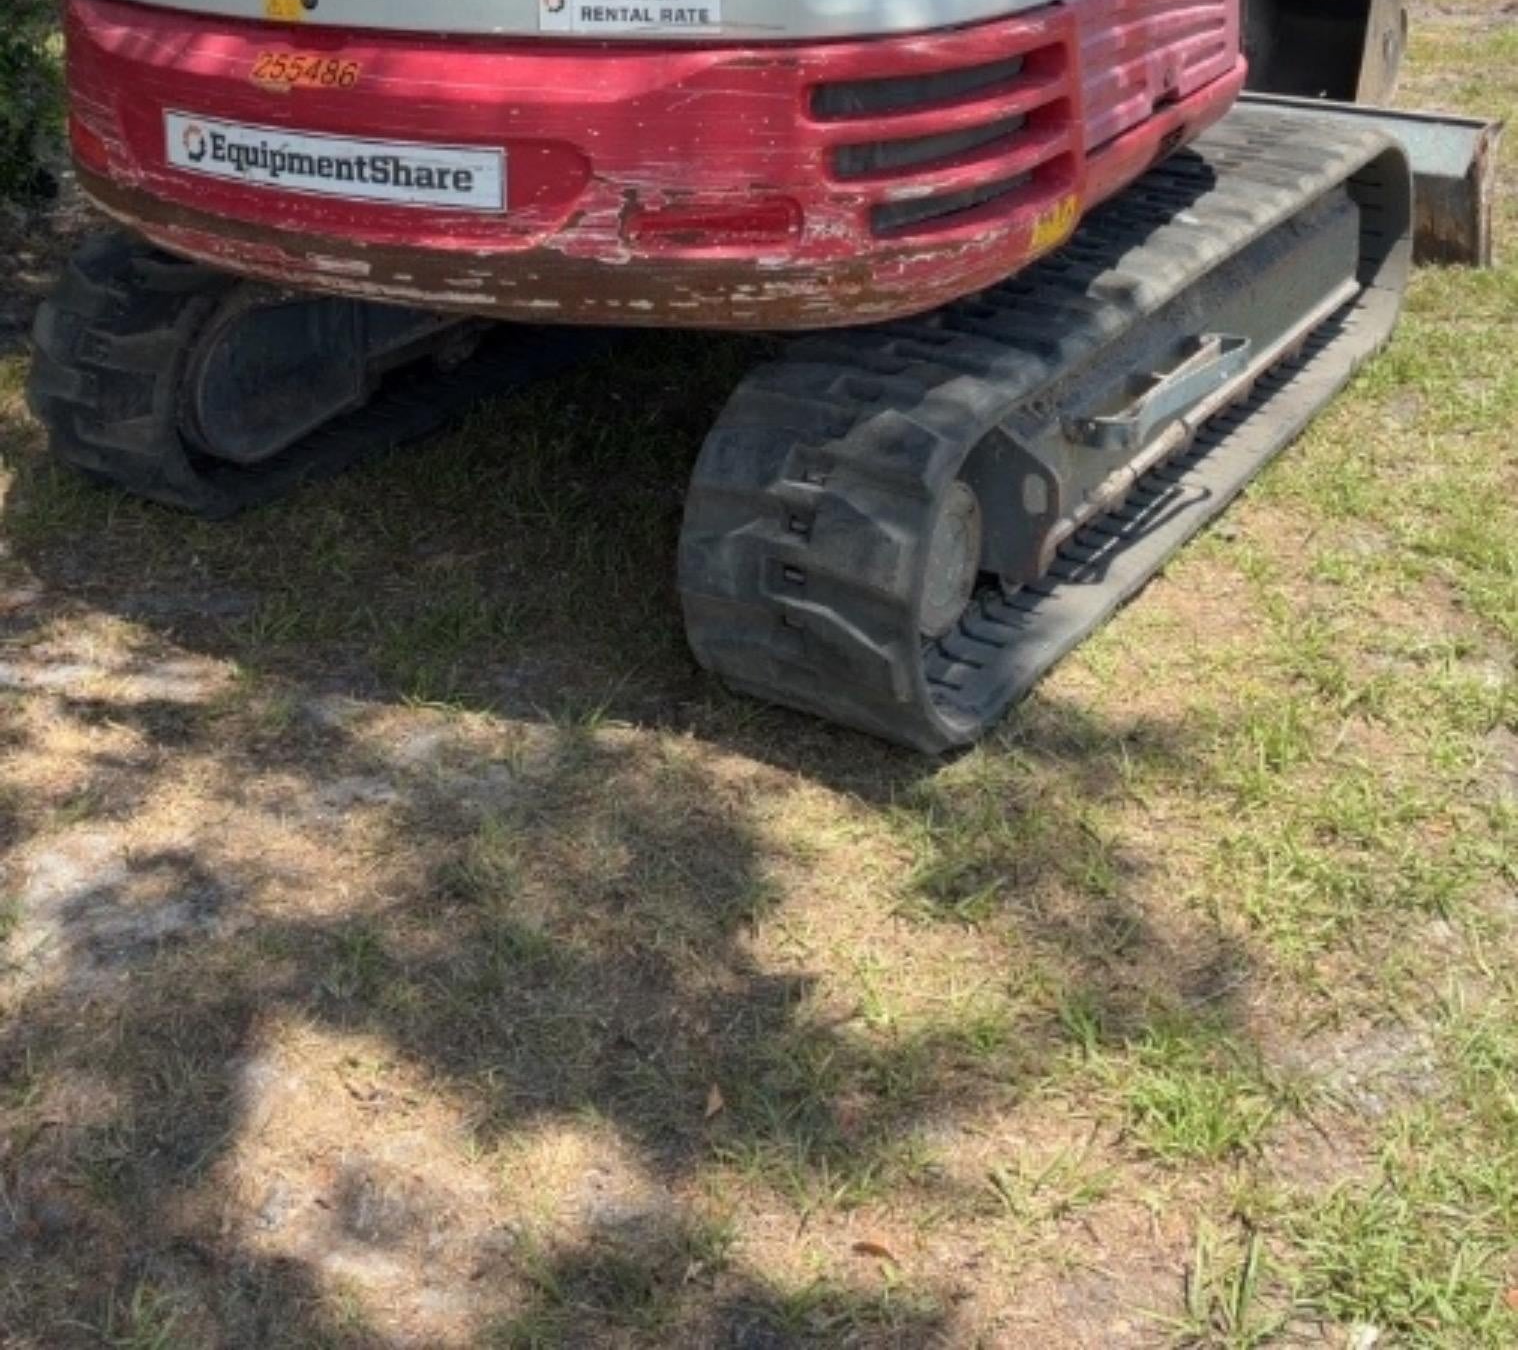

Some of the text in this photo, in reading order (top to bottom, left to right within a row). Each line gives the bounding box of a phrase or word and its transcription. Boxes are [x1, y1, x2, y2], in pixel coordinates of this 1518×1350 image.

[580, 5, 711, 25] RENTAL RATE
[252, 51, 359, 88] 255486
[209, 131, 474, 193] EquipmentShare
